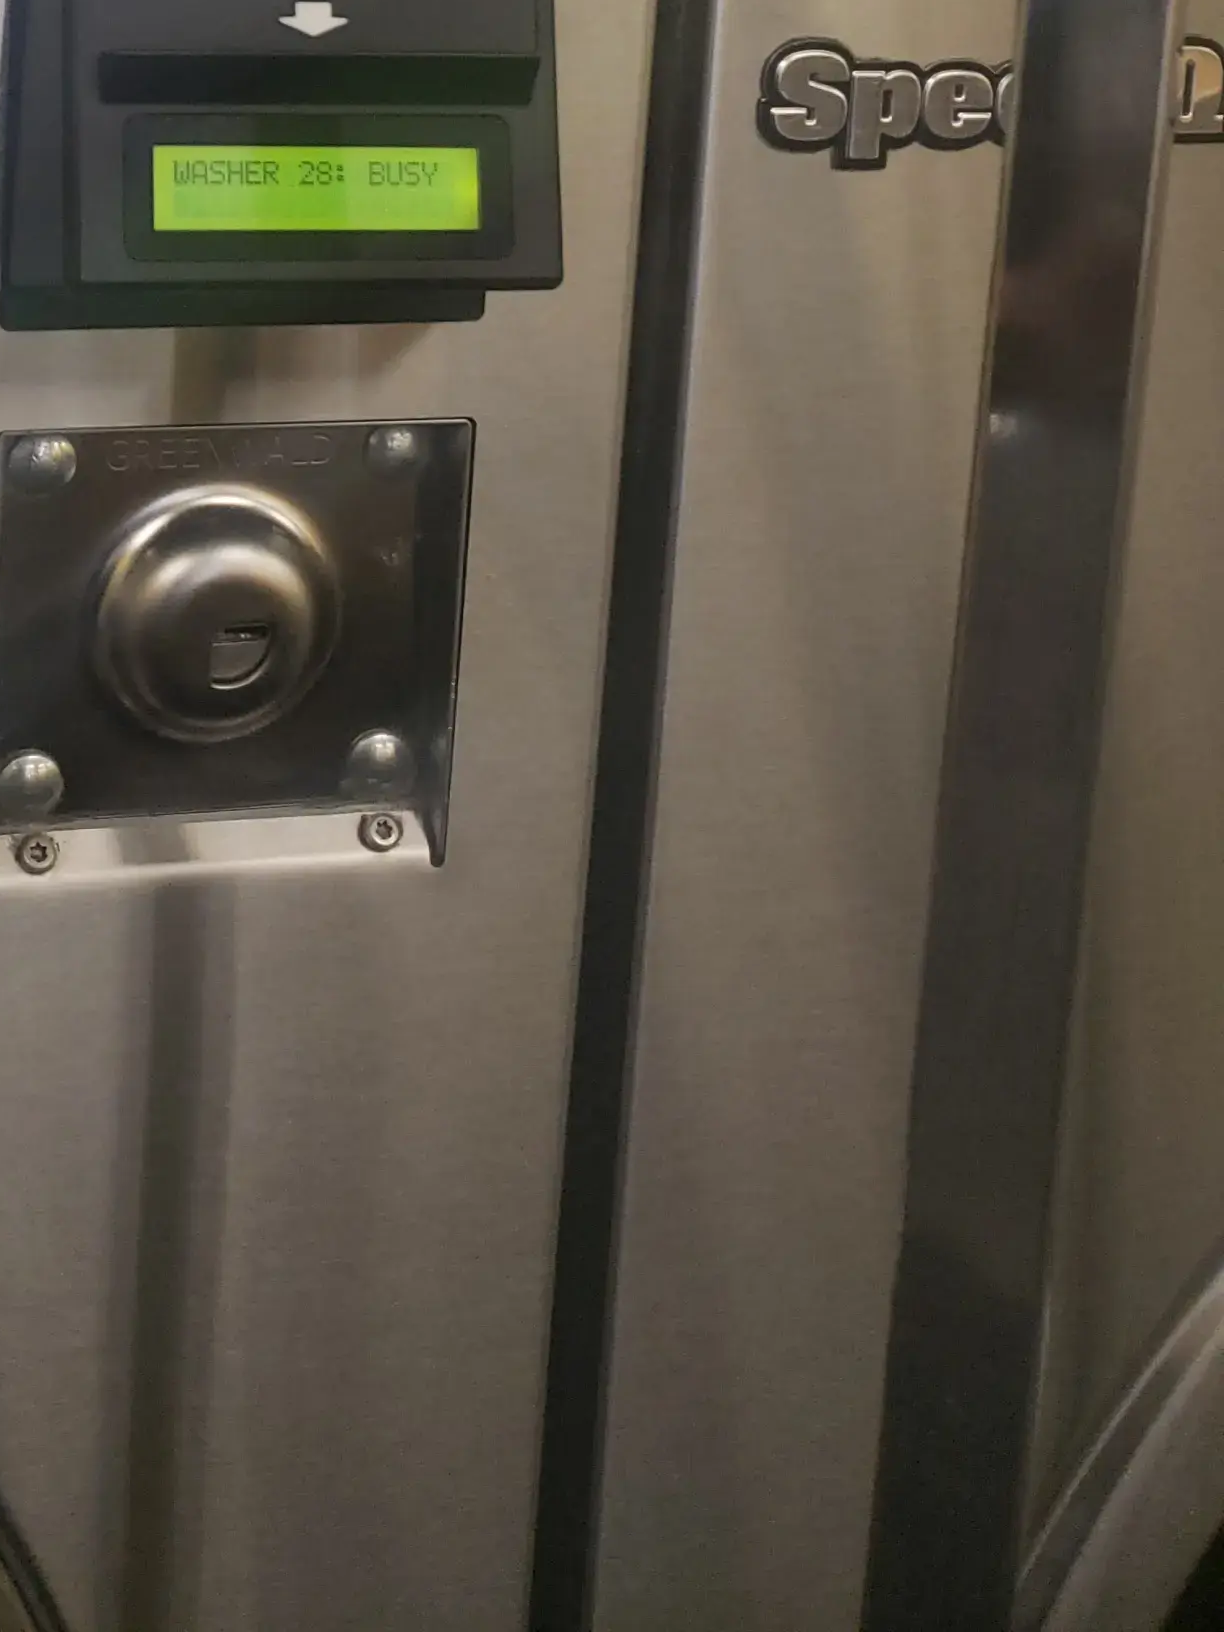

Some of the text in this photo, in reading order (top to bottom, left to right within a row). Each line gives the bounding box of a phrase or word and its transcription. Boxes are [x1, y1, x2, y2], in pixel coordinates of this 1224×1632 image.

[757, 37, 1015, 170] Spe
[172, 160, 439, 187] WASHER 28: BUSY
